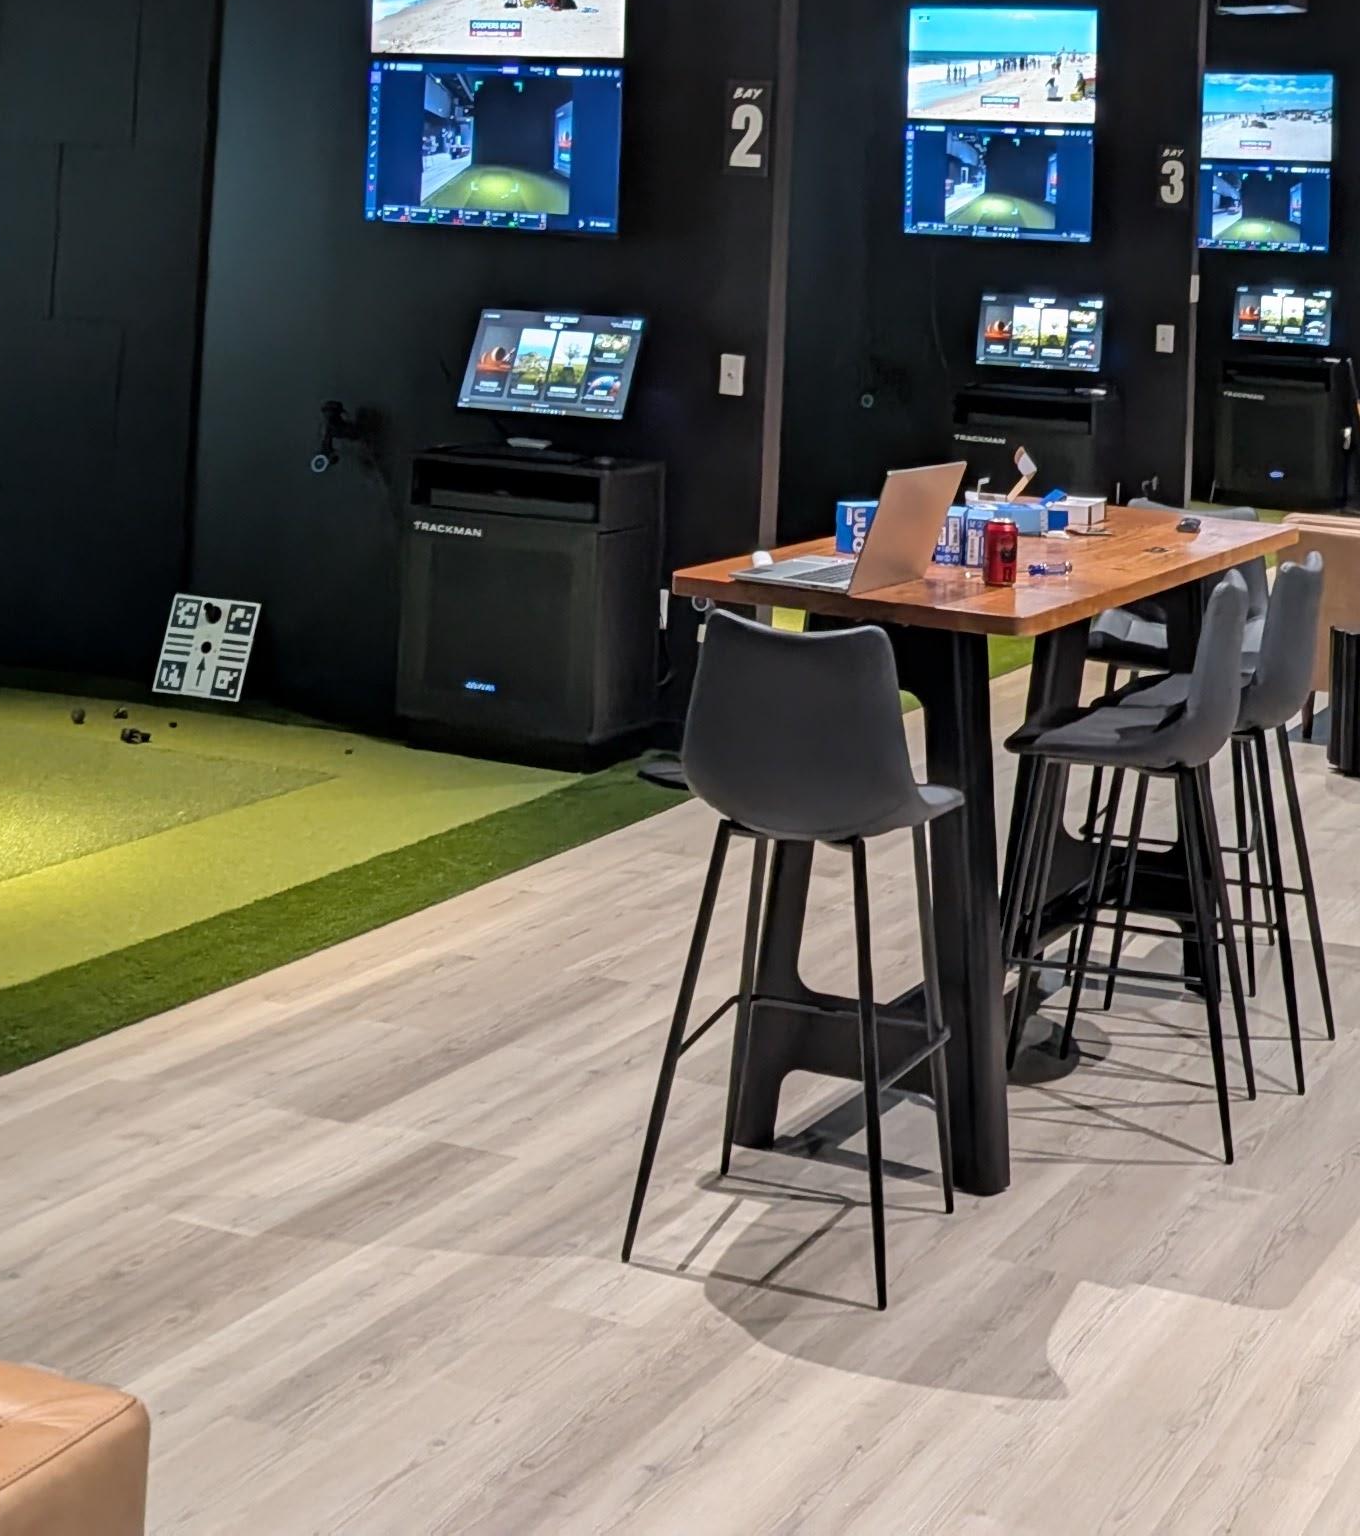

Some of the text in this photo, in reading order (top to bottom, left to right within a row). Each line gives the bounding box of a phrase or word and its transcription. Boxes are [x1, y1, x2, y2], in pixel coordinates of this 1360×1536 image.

[732, 87, 763, 100] BAY
[728, 104, 763, 168] 2
[1162, 148, 1185, 158] BAY
[1160, 160, 1185, 204] 3
[413, 520, 483, 537] TRACKMAN
